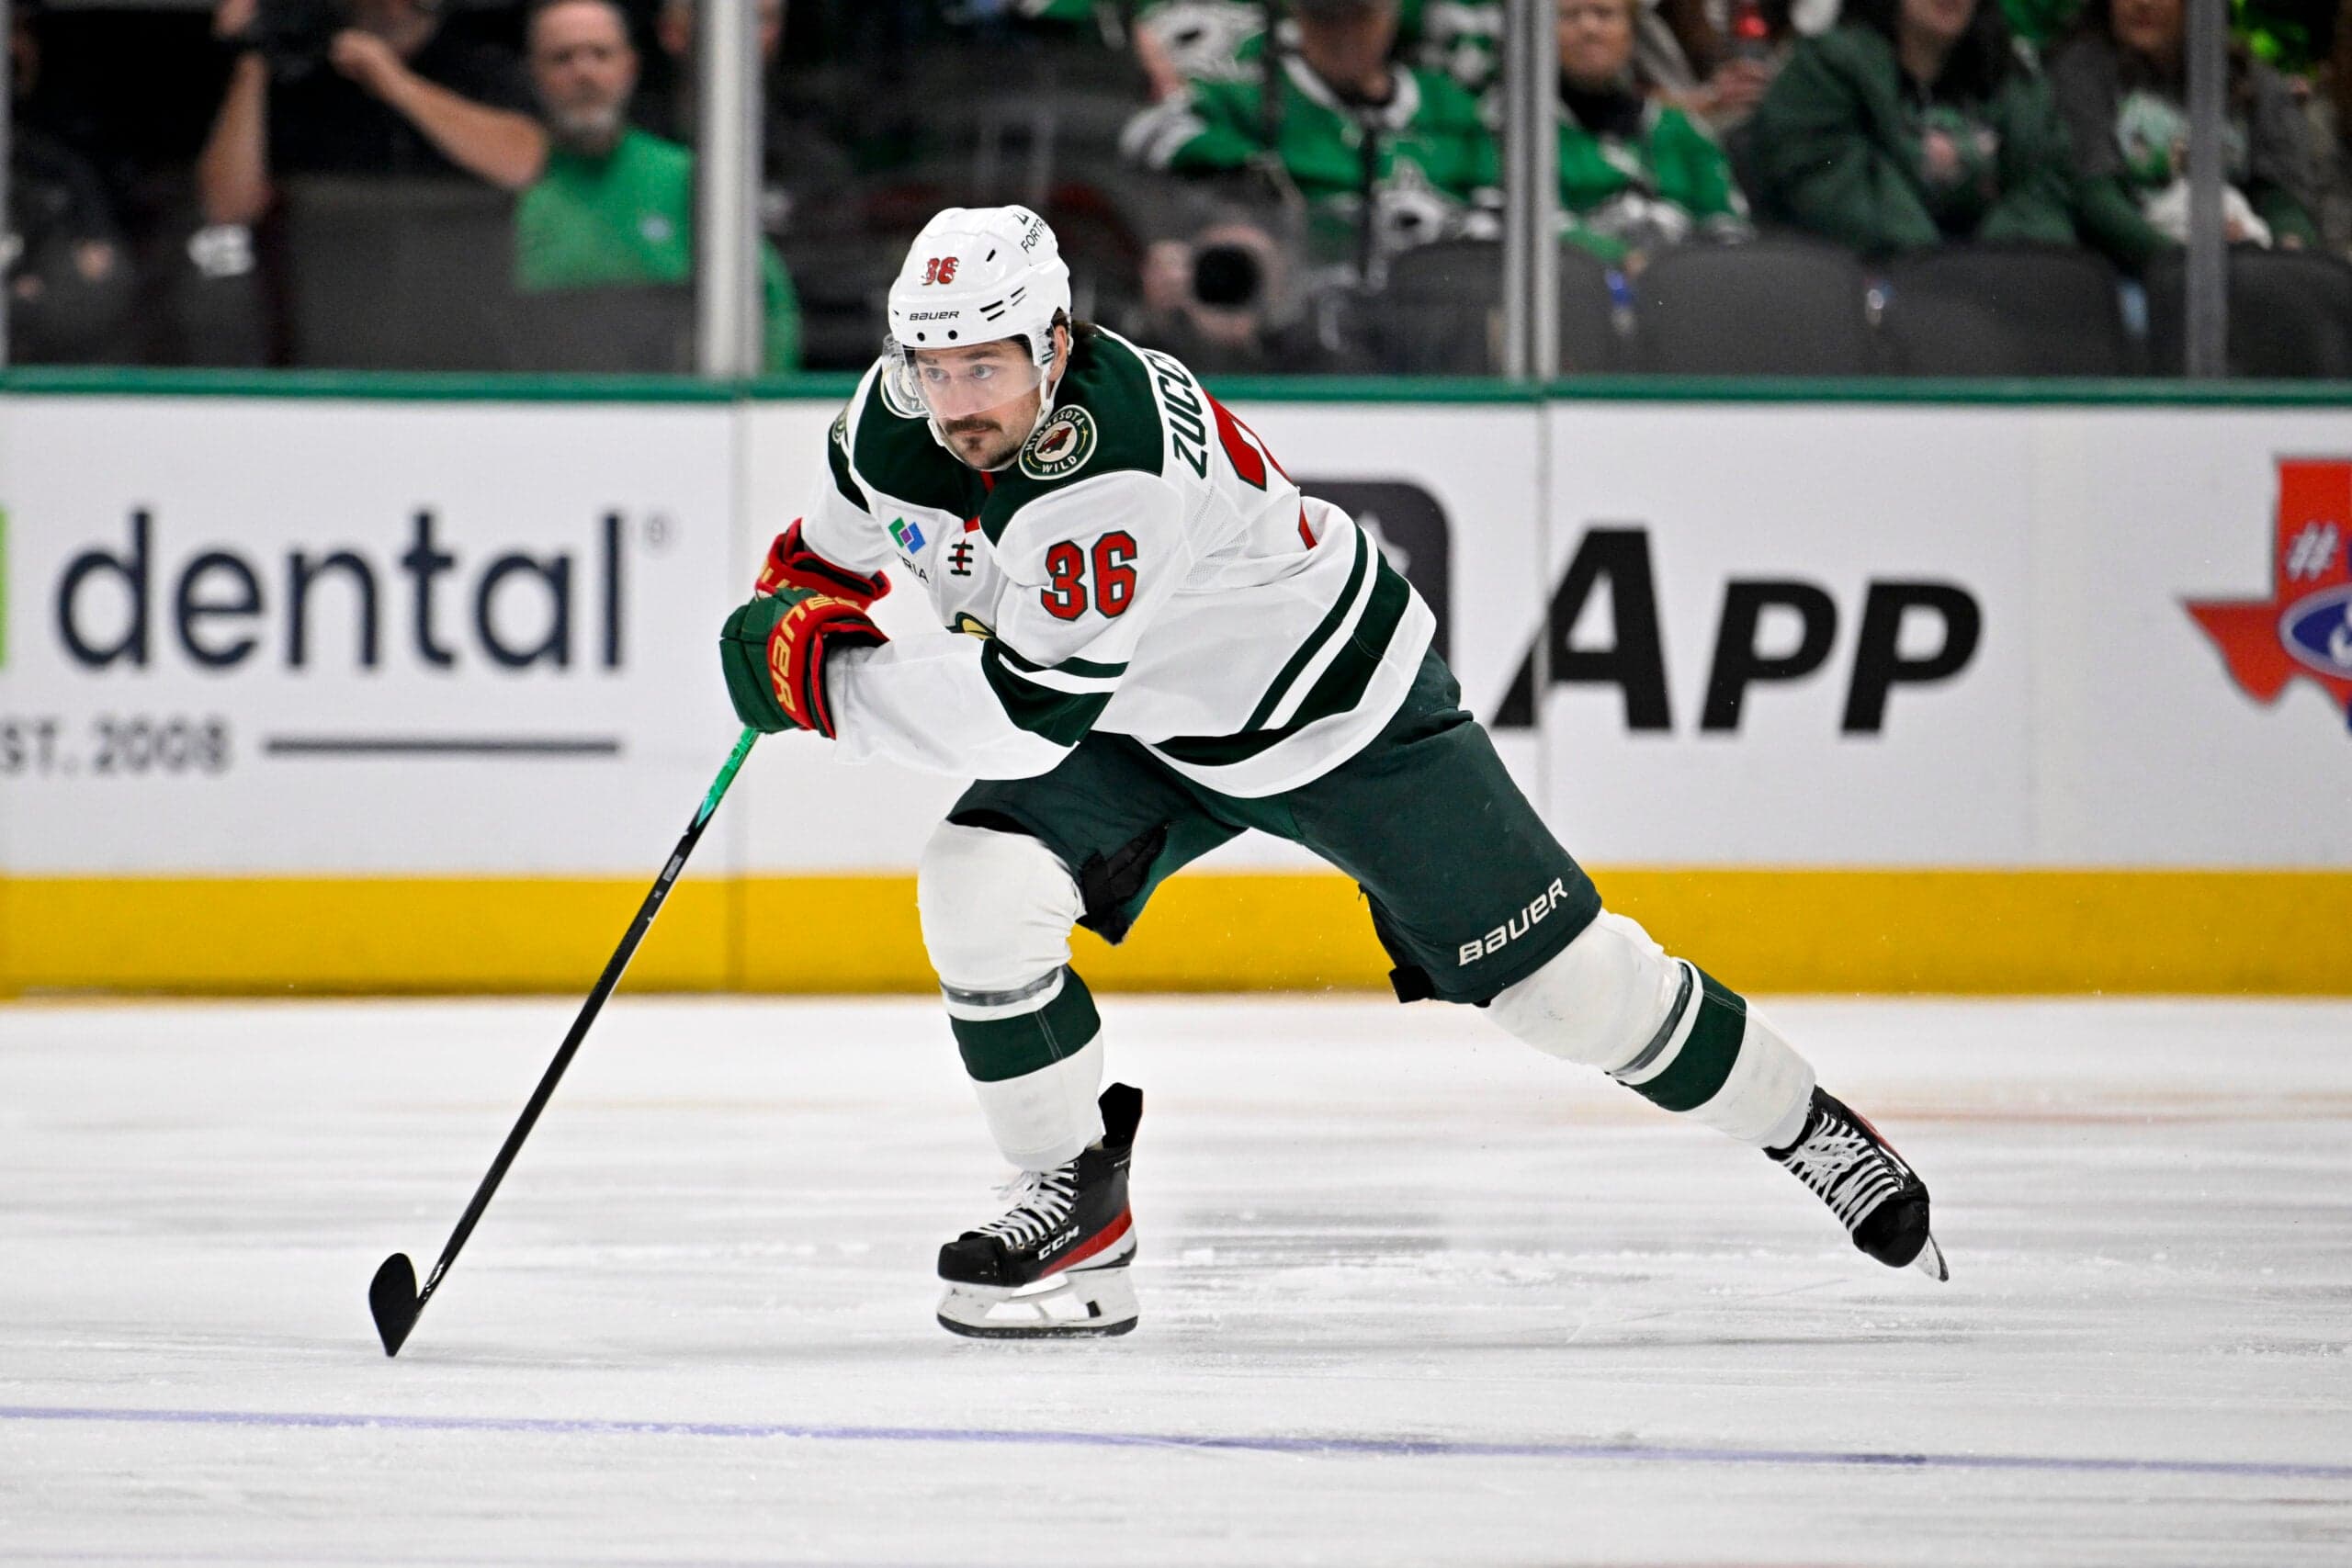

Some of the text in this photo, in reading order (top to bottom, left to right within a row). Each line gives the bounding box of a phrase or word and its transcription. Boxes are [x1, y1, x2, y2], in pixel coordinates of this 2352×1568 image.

[1020, 217, 1047, 254] FORTR
[922, 256, 960, 286] 36
[1143, 348, 1208, 479] ZUCC
[1041, 455, 1078, 473] WILD
[896, 551, 929, 583] RIA
[1040, 530, 1138, 622] 36
[55, 509, 626, 671] dental
[1037, 1225, 1080, 1260] CCM
